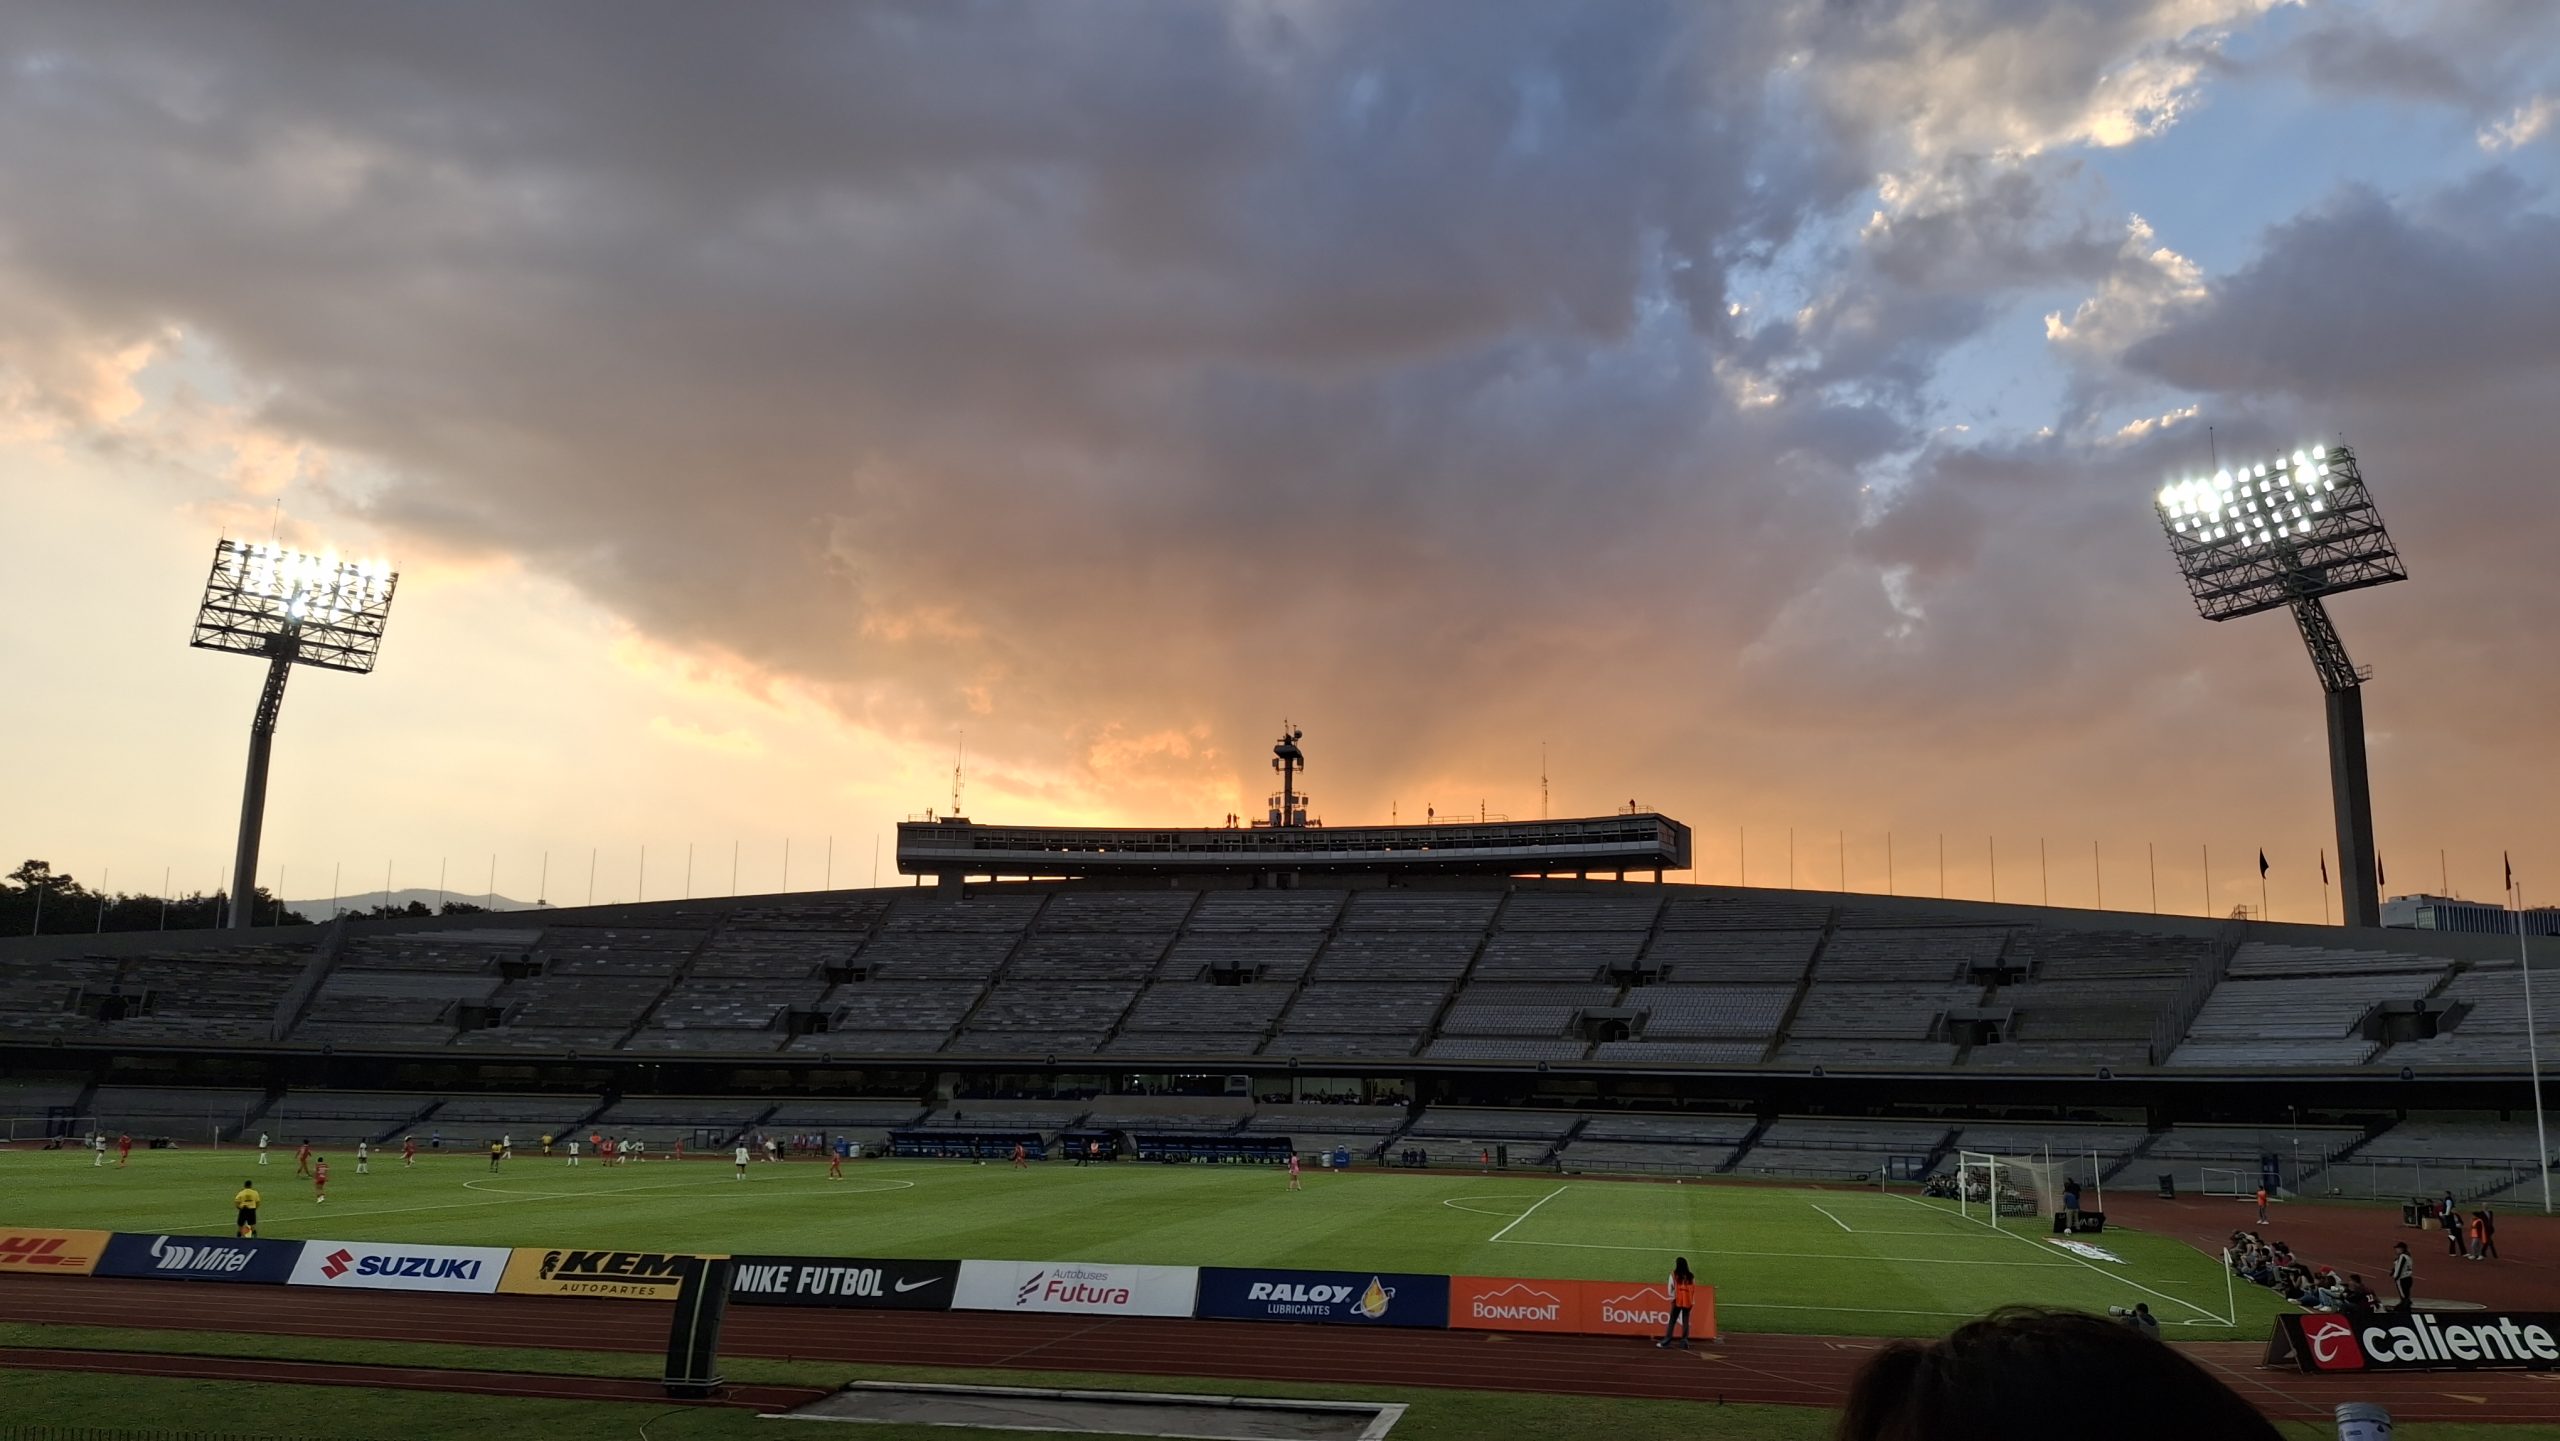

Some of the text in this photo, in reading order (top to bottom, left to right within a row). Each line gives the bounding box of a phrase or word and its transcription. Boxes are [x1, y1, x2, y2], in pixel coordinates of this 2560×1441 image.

[0, 1238, 66, 1264] HL
[190, 1247, 258, 1272] Mifel
[357, 1256, 481, 1280] SUZUKI
[560, 1251, 694, 1276] KEM
[1050, 1268, 1108, 1281] Autobuses
[560, 1283, 656, 1297] AUTOPARTES
[733, 1264, 884, 1297] NIKE FUTBOL
[1043, 1279, 1130, 1305] Futura
[1247, 1282, 1352, 1304] RALOY
[1267, 1304, 1331, 1316] LUBRICANTES
[1473, 1302, 1560, 1321] BONAFONT
[2362, 1313, 2559, 1363] caliente
